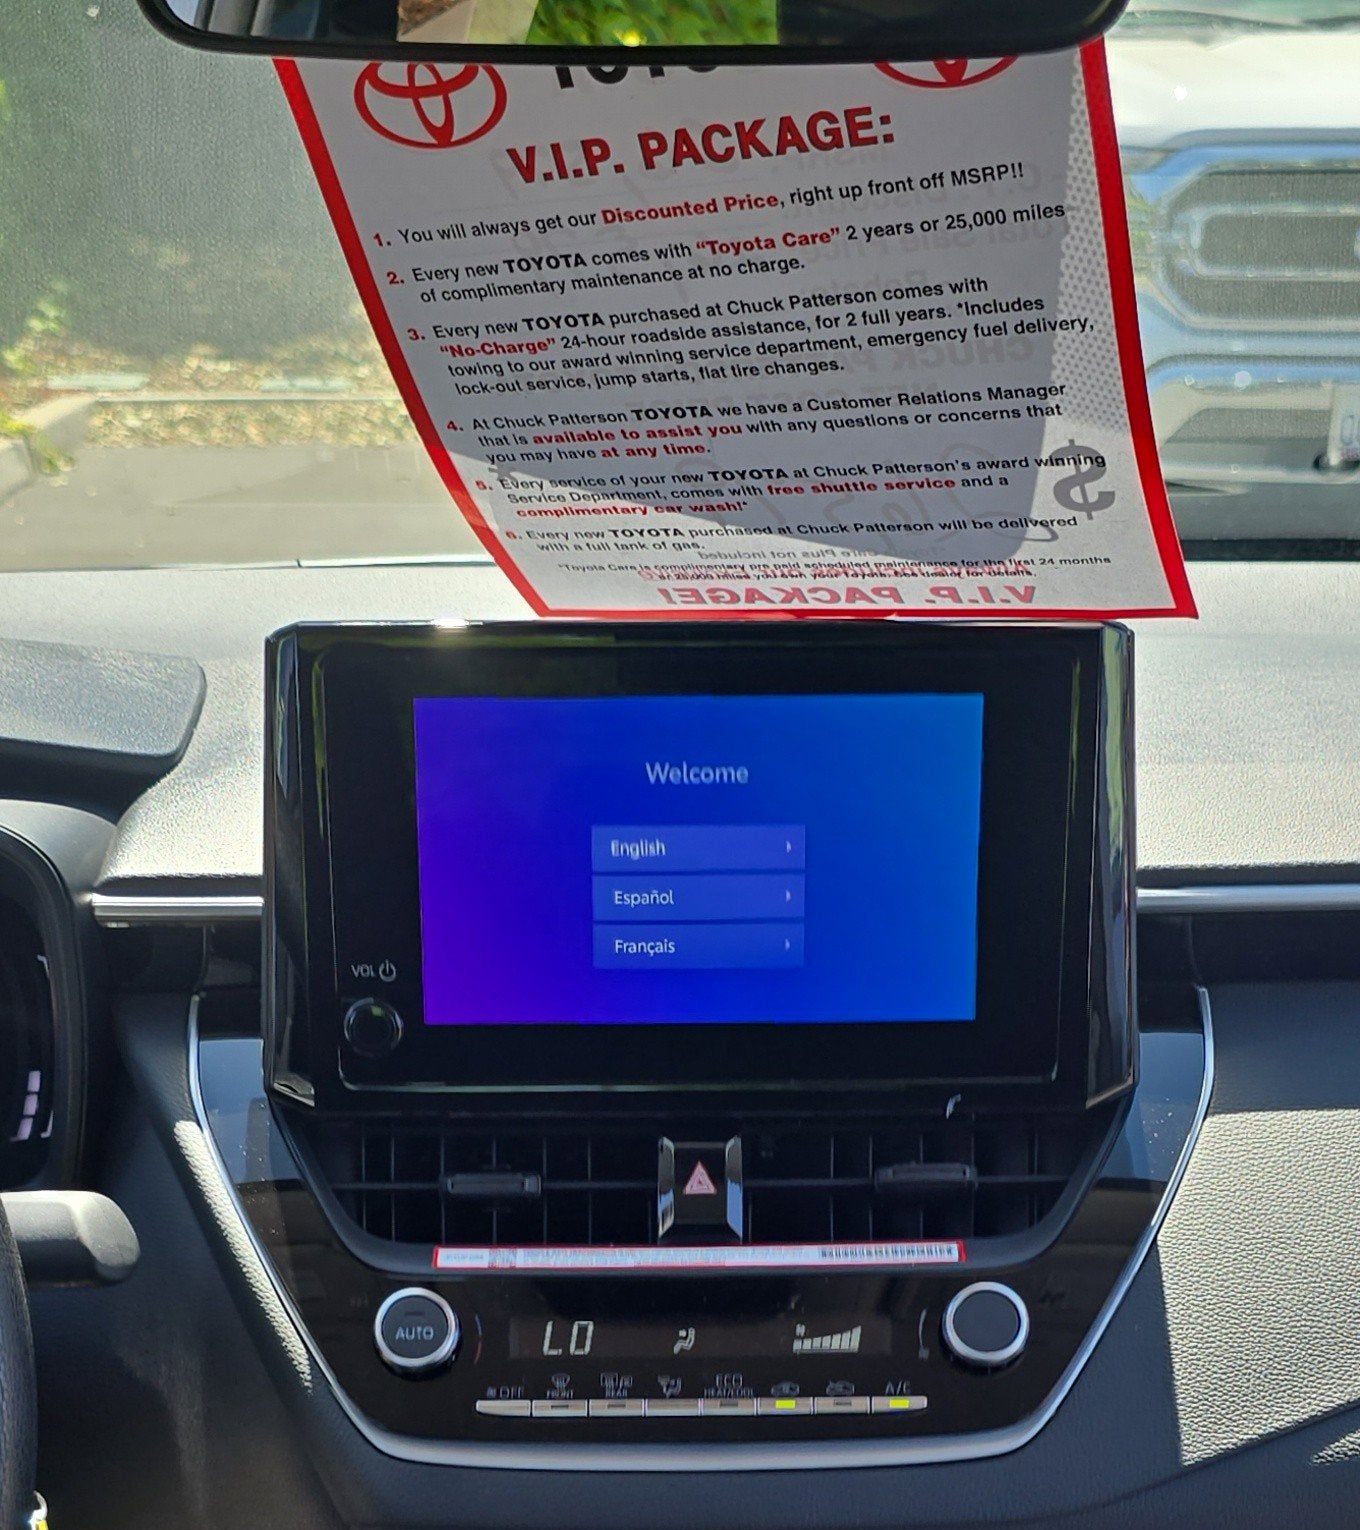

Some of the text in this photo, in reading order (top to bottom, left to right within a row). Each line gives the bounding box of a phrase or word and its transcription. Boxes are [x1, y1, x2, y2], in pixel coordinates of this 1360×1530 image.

[506, 106, 896, 183] V.I.P. PACKAGE:
[373, 162, 1023, 247] 1. You will always get our Discounted Price, right up front off MSRP!!
[386, 271, 405, 285] 2.
[411, 267, 459, 283] Every
[465, 264, 499, 278] new
[502, 252, 588, 274] TOYOTA
[591, 250, 650, 266] comes
[653, 242, 692, 260] with
[846, 225, 858, 240] 2
[862, 222, 914, 243] years
[920, 219, 939, 232] or
[945, 208, 1007, 231] 25,000
[1013, 204, 1065, 223] miles
[420, 258, 805, 303] of complimentary maintenance at no charge.
[407, 277, 988, 341] 3. Every new TOYOTA purchased at Chuck Patterson comes with
[560, 334, 626, 349] 24-hour
[630, 325, 707, 345] roadside
[711, 320, 811, 338] assistance,
[815, 314, 841, 330] for
[845, 312, 858, 327] 2
[861, 308, 891, 326] full
[895, 307, 952, 327] years.
[448, 317, 1094, 378] towing to our award winning service department, emergency fuel delivery,
[455, 360, 844, 395] lock-out service, jump starts, flat tire changes.
[447, 384, 1065, 431] 4. At Chuck Patterson TOYOTA we have a Customer Relations Manager
[645, 761, 749, 785] Welcome
[610, 839, 666, 860] English
[614, 889, 675, 908] Español
[614, 939, 676, 957] Français
[350, 963, 377, 978] VOL
[394, 1326, 435, 1341] AUTO
[542, 1320, 594, 1356] LO
